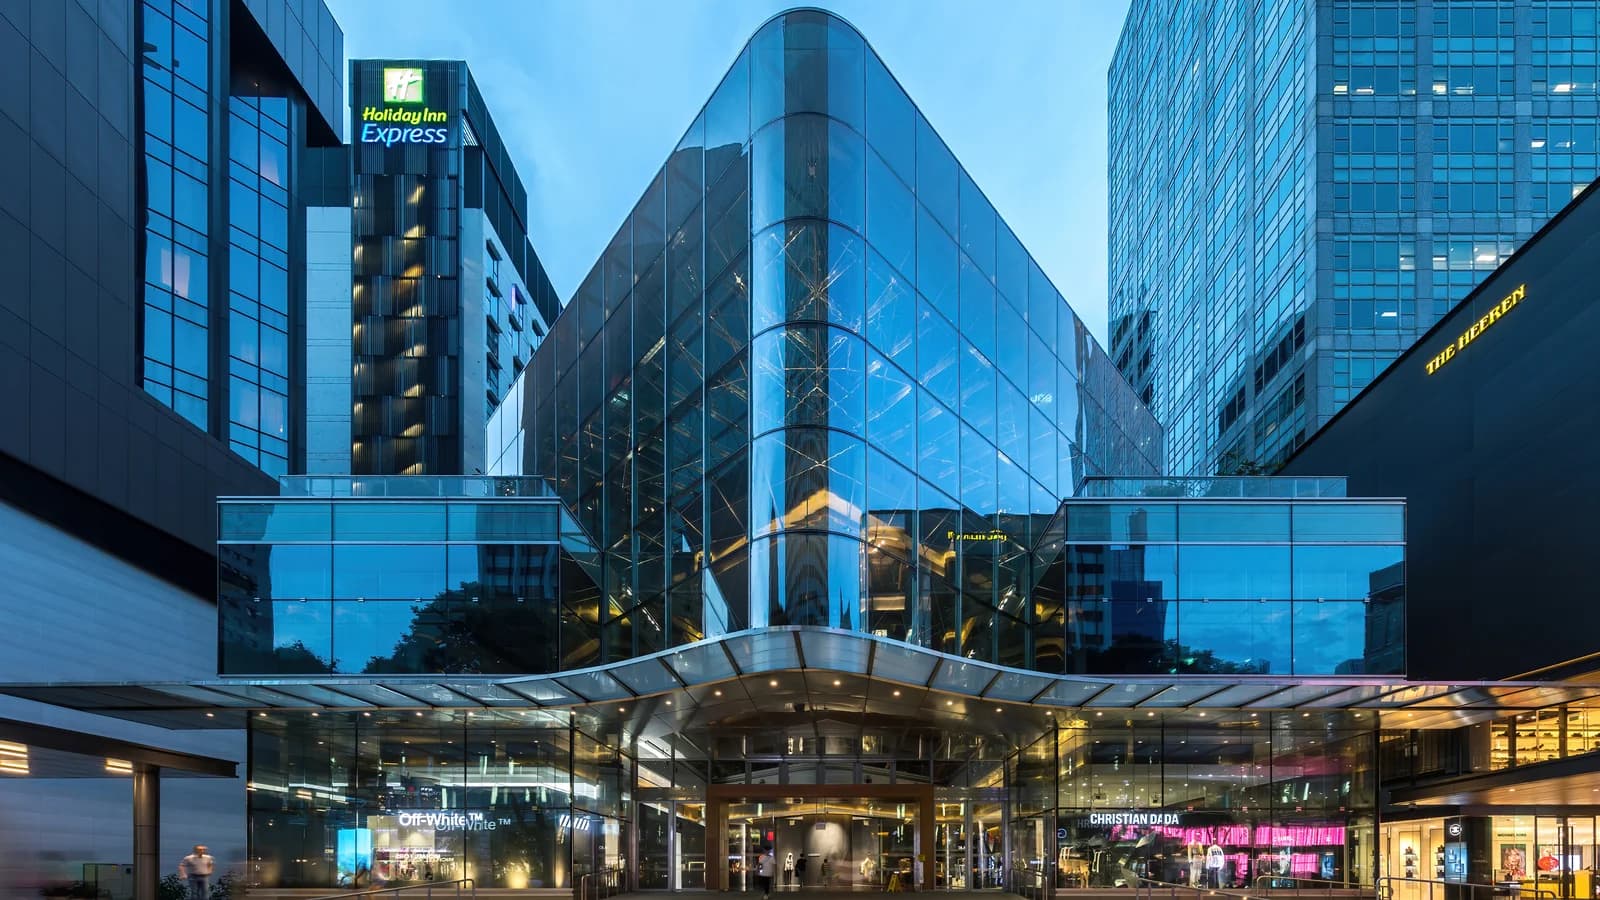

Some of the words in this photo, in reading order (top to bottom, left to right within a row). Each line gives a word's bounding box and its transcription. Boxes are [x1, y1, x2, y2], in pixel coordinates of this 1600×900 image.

[363, 107, 421, 125] Holiday
[424, 108, 447, 122] Inn
[361, 123, 447, 147] Express
[1425, 344, 1456, 375] THE
[1457, 283, 1527, 350] HEEREN
[1090, 813, 1147, 825] CHRISTIAN
